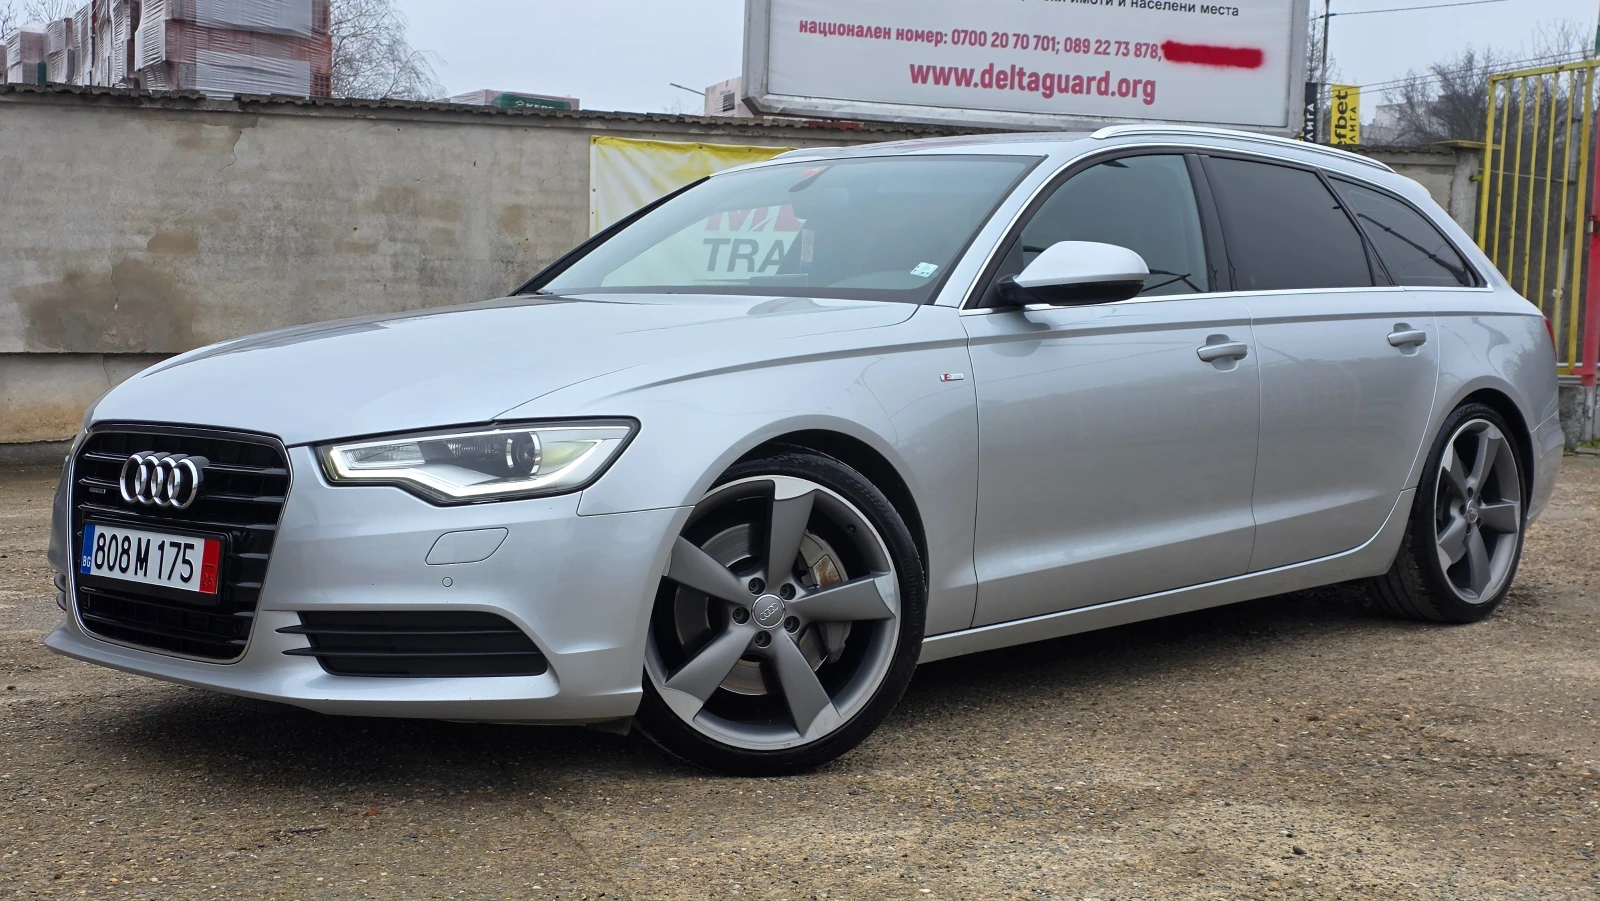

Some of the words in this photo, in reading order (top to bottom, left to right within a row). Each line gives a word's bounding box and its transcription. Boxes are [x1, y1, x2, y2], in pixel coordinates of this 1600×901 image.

[1131, 0, 1196, 13] населени
[1200, 4, 1239, 17] места
[799, 20, 892, 40] национален
[896, 28, 948, 47] номер:
[951, 29, 987, 47] 0700
[991, 32, 1009, 48] 20
[1012, 33, 1030, 50] 70
[1033, 35, 1061, 55] 701;
[1064, 37, 1091, 54] 089
[1094, 39, 1111, 56] 22
[1114, 41, 1130, 57] 73
[1134, 42, 1162, 62] 878,
[909, 63, 1156, 106] www.deltaguard.org
[1306, 103, 1315, 141] ЛИГА
[1334, 90, 1348, 144] fbet
[82, 555, 92, 568] BG
[94, 532, 132, 574] 808
[134, 537, 151, 577] M
[158, 540, 195, 583] 175
